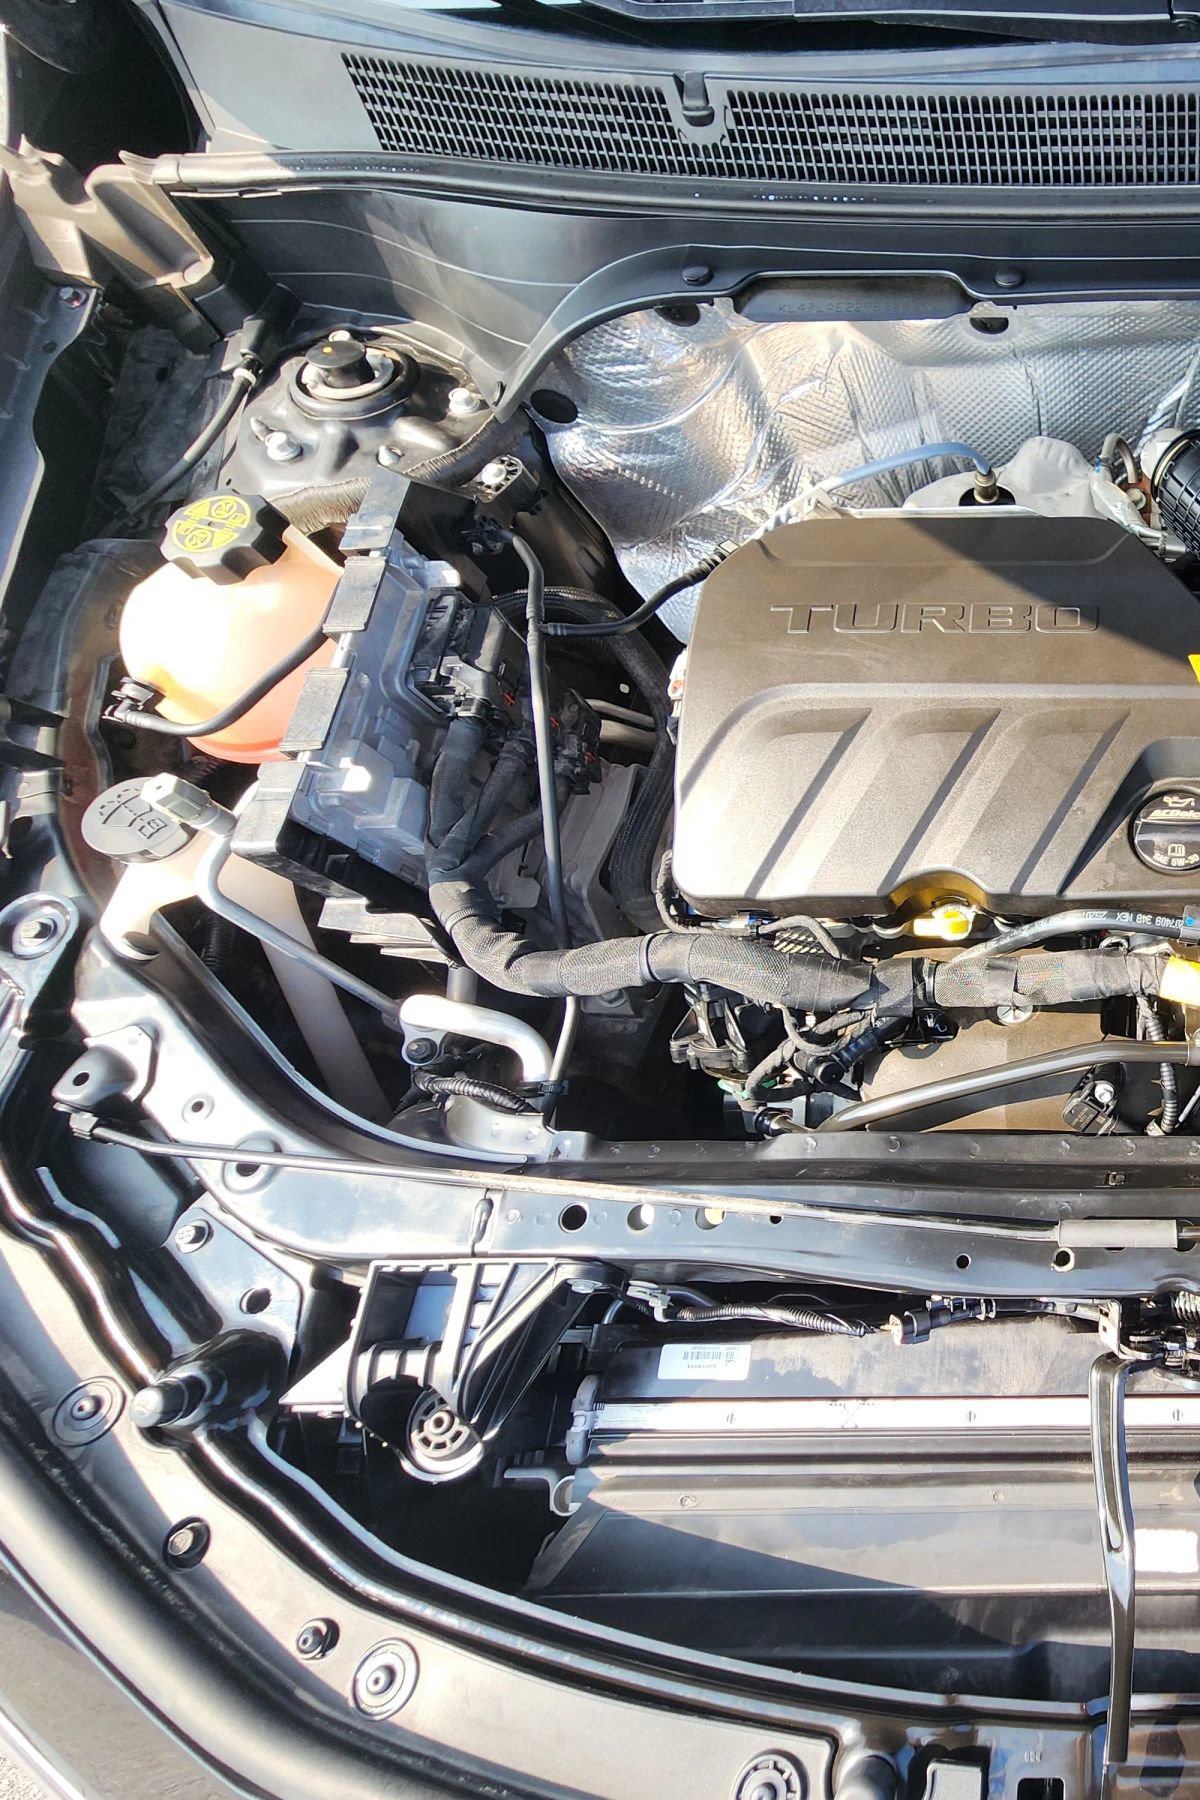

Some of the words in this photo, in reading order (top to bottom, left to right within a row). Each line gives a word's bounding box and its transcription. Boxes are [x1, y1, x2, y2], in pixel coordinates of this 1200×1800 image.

[770, 602, 1099, 634] TURBO
[1153, 853, 1169, 865] SAE
[1171, 853, 1200, 866] 5W-30
[1116, 911, 1133, 922] MEX
[1136, 913, 1152, 925] 348
[1155, 918, 1184, 930] 207409
